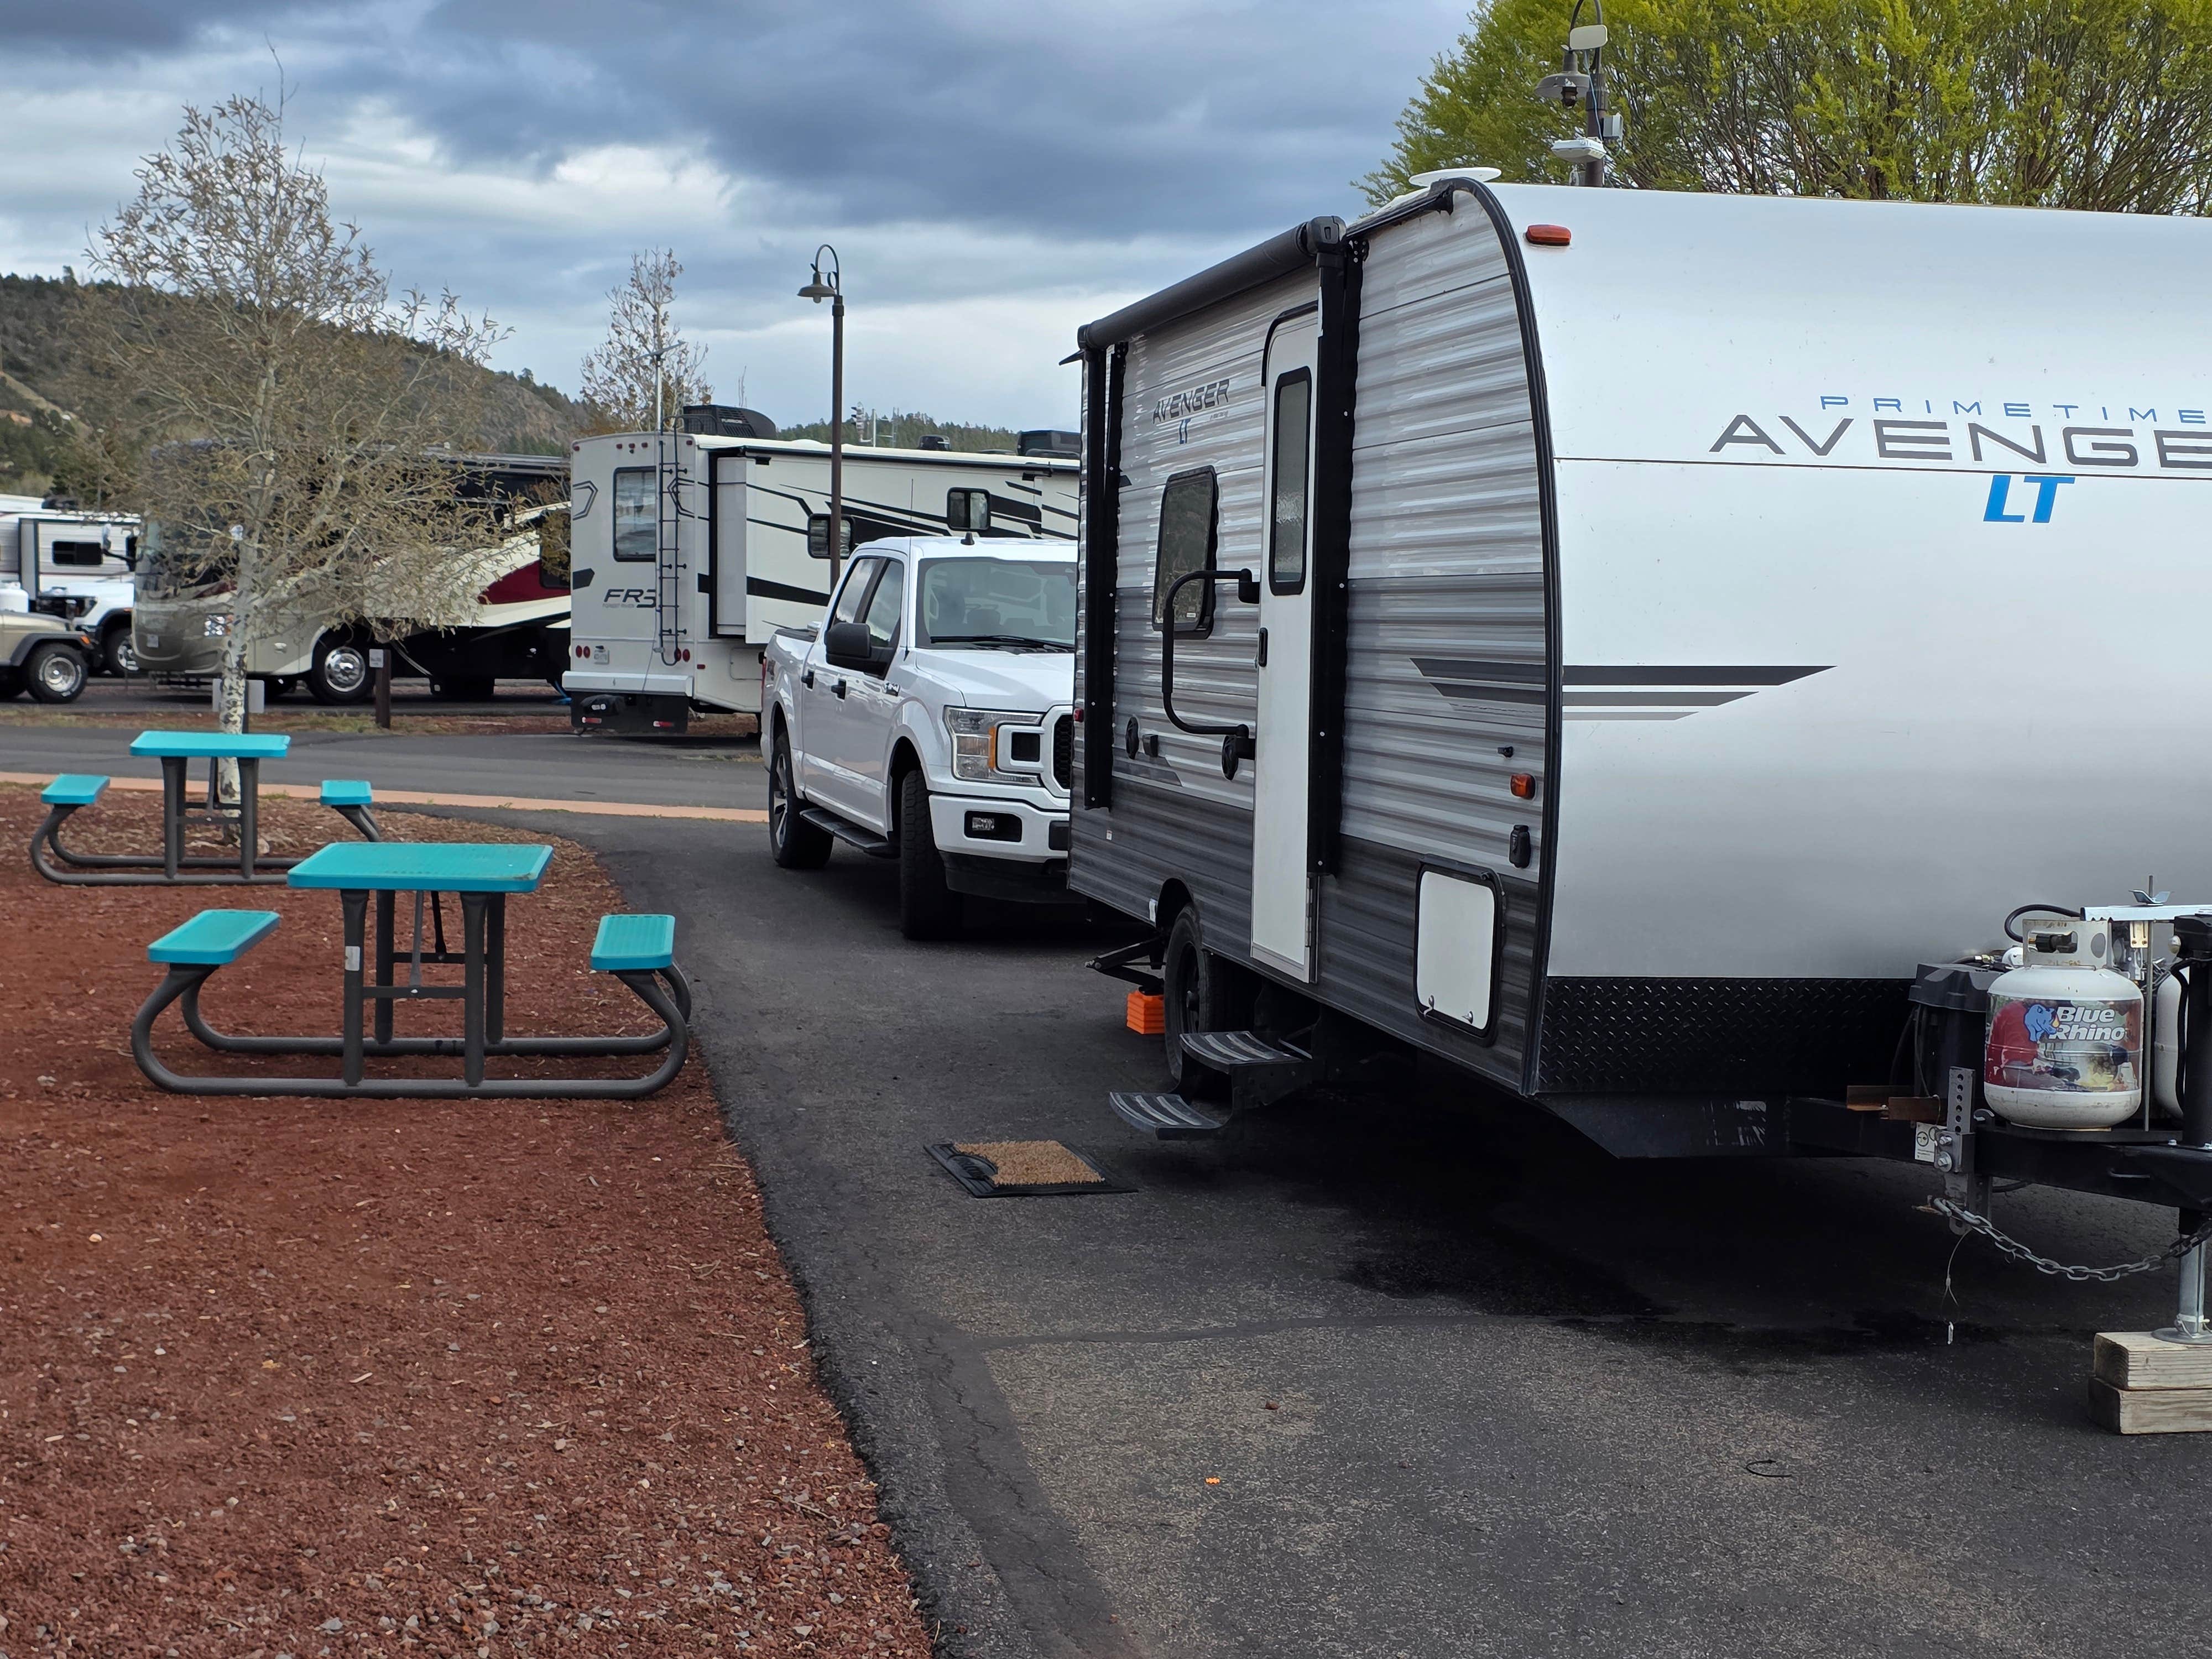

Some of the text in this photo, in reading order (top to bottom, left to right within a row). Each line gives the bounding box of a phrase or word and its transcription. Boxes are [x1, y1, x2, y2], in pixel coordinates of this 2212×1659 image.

[1152, 379, 1230, 424] AVENGER
[1820, 396, 2206, 424] PRIMETIME
[1179, 418, 1191, 444] LT
[1709, 414, 2212, 469] AVENGE
[1983, 475, 2076, 523] LT
[2056, 1006, 2115, 1023] Blue
[2048, 1024, 2127, 1041] Rhino
